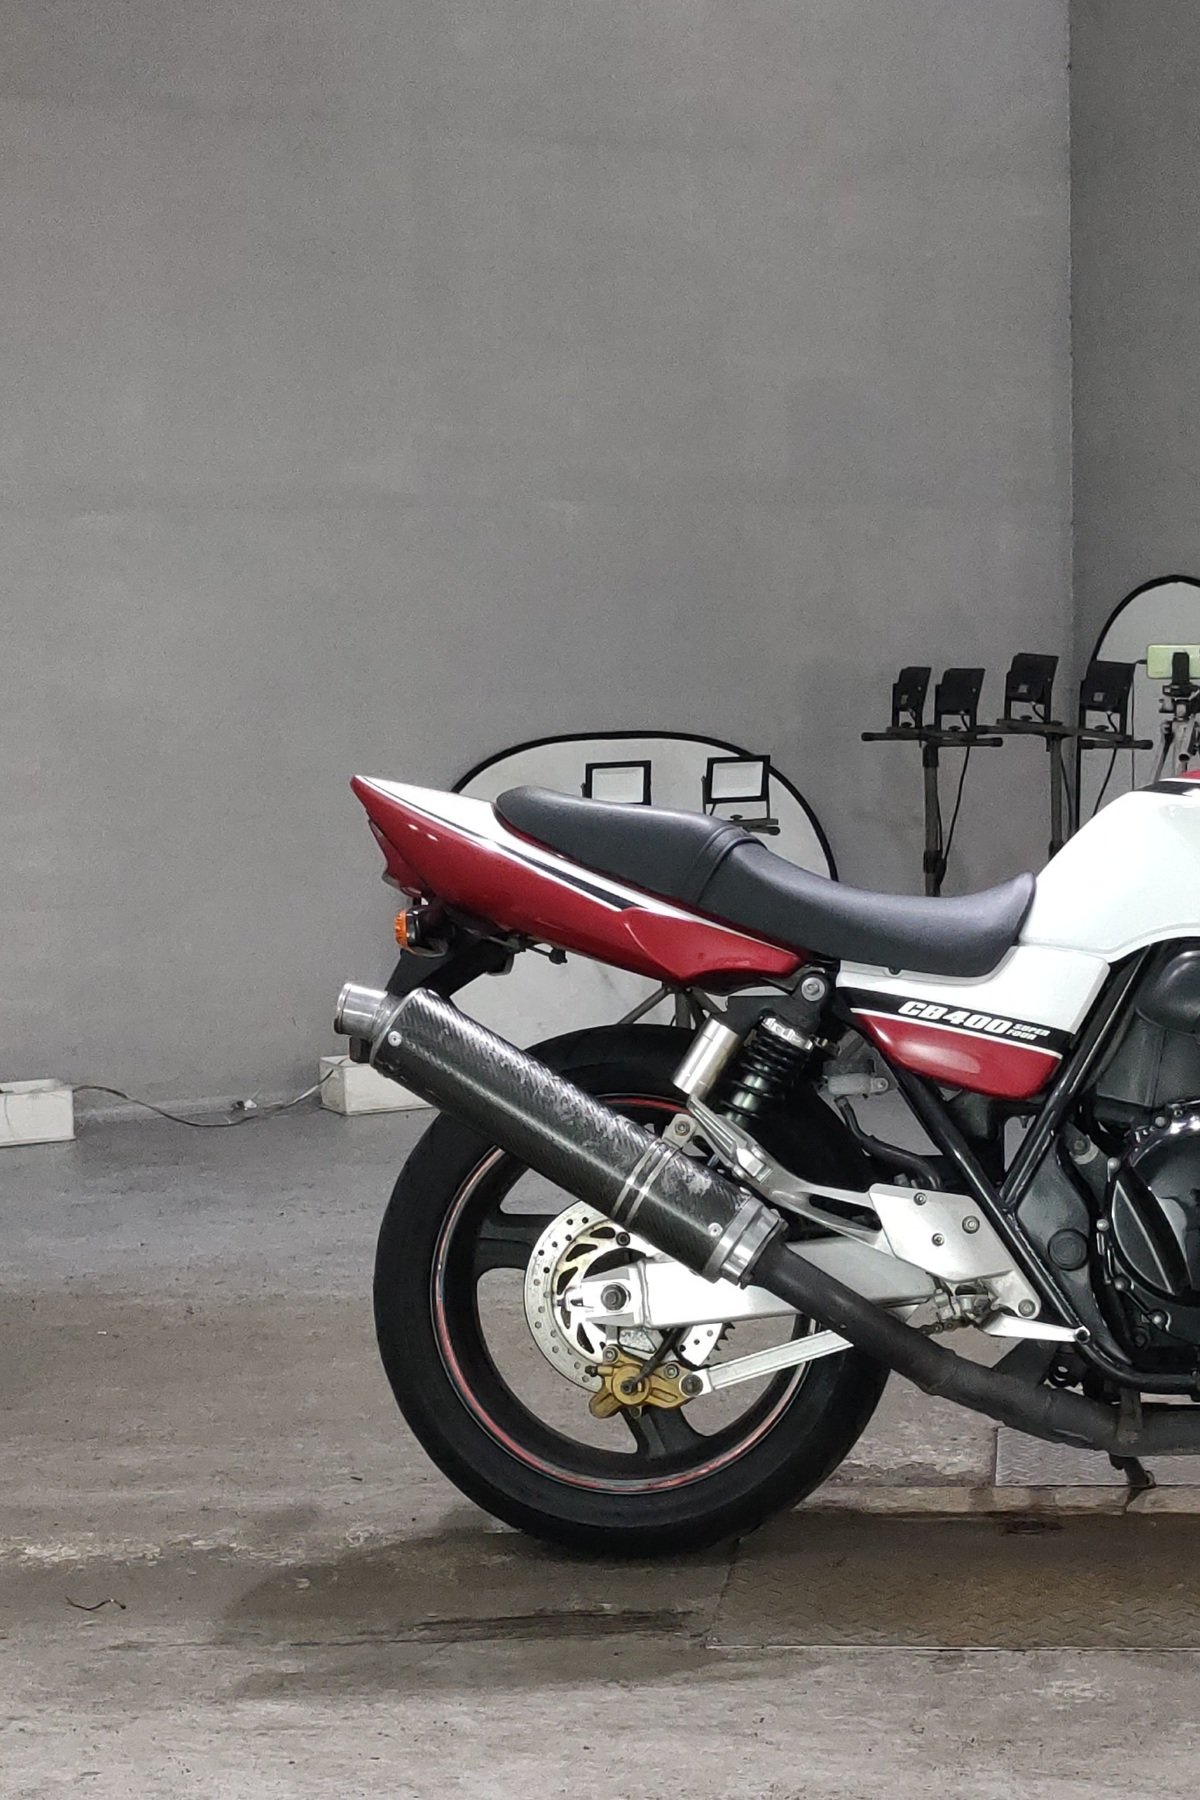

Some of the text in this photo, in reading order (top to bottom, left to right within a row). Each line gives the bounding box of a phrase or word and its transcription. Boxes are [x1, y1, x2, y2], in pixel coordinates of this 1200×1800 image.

[898, 1001, 1013, 1034] CB400
[1006, 1029, 1038, 1041] FOUR
[1012, 1023, 1051, 1037] SUPER
